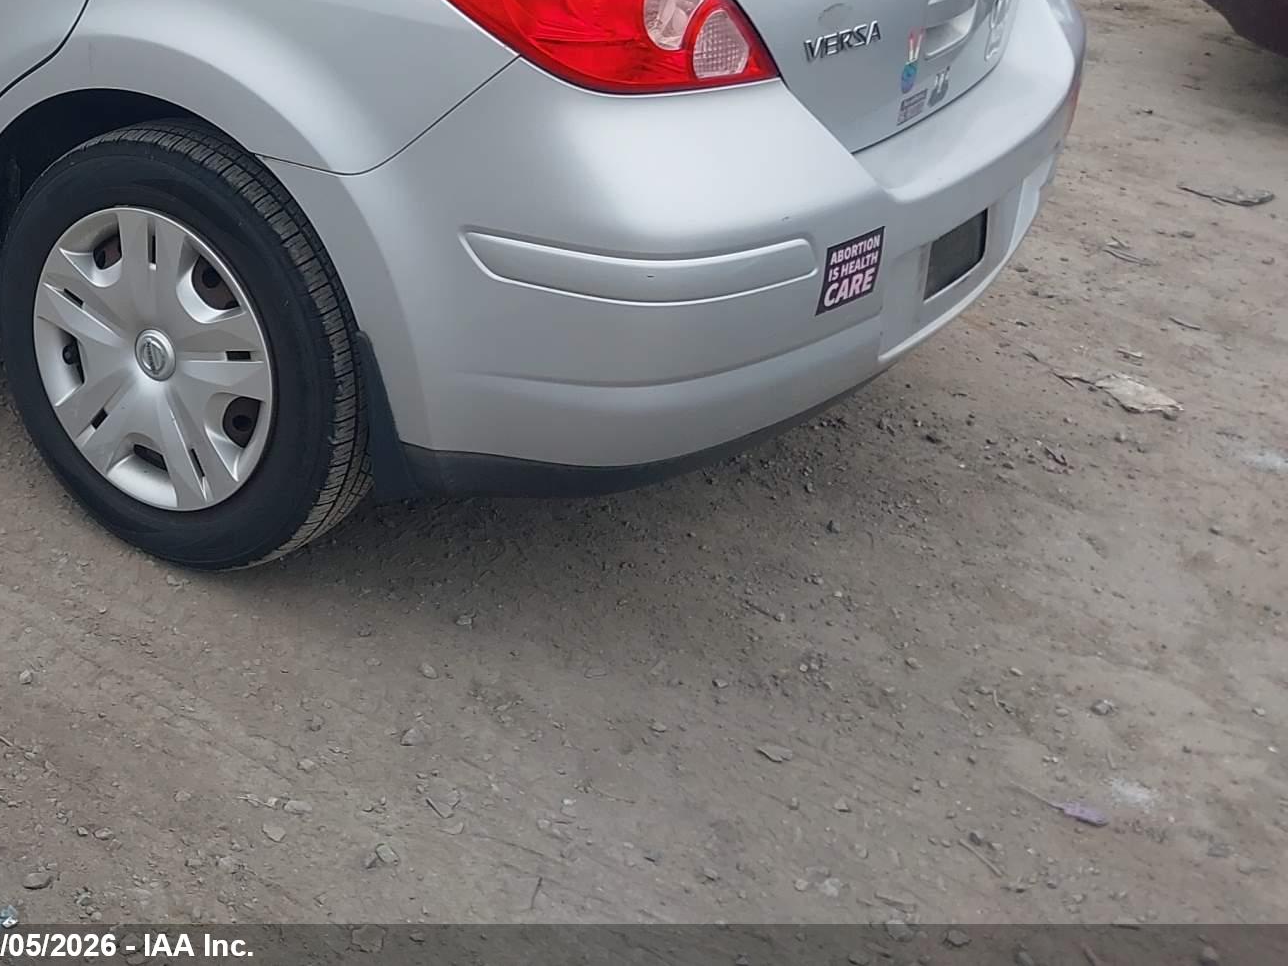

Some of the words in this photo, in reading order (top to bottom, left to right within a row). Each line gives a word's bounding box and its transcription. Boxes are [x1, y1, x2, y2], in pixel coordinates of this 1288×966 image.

[804, 20, 880, 62] VERSA
[828, 267, 840, 282] IS
[840, 251, 879, 277] HEALTH
[830, 235, 880, 265] ABORTION
[824, 267, 875, 307] CARE
